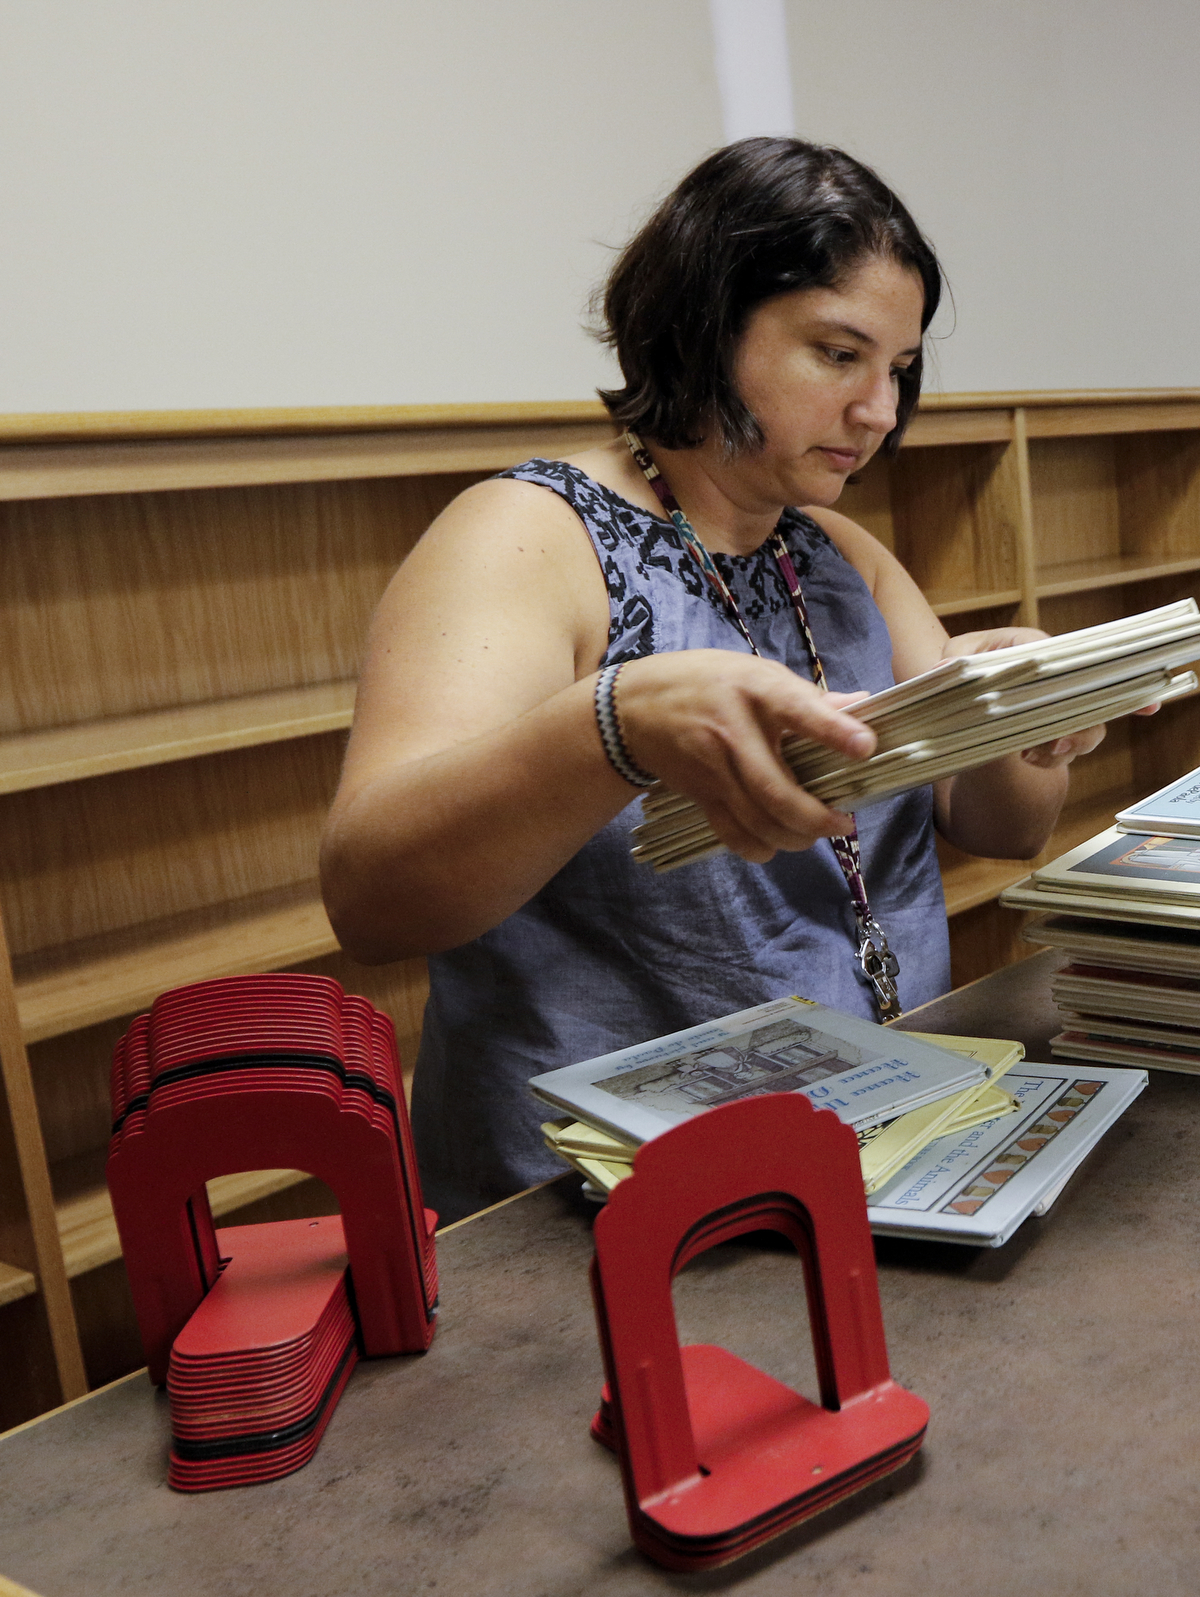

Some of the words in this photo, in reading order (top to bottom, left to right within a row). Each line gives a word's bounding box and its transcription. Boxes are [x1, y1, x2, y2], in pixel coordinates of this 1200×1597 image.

[690, 1036, 716, 1048] and
[839, 1058, 909, 1085] Nana
[850, 1070, 921, 1097] Nana
[1014, 1081, 1044, 1098] The
[958, 1130, 984, 1148] and
[940, 1149, 969, 1164] the
[895, 1164, 951, 1206] Animals
